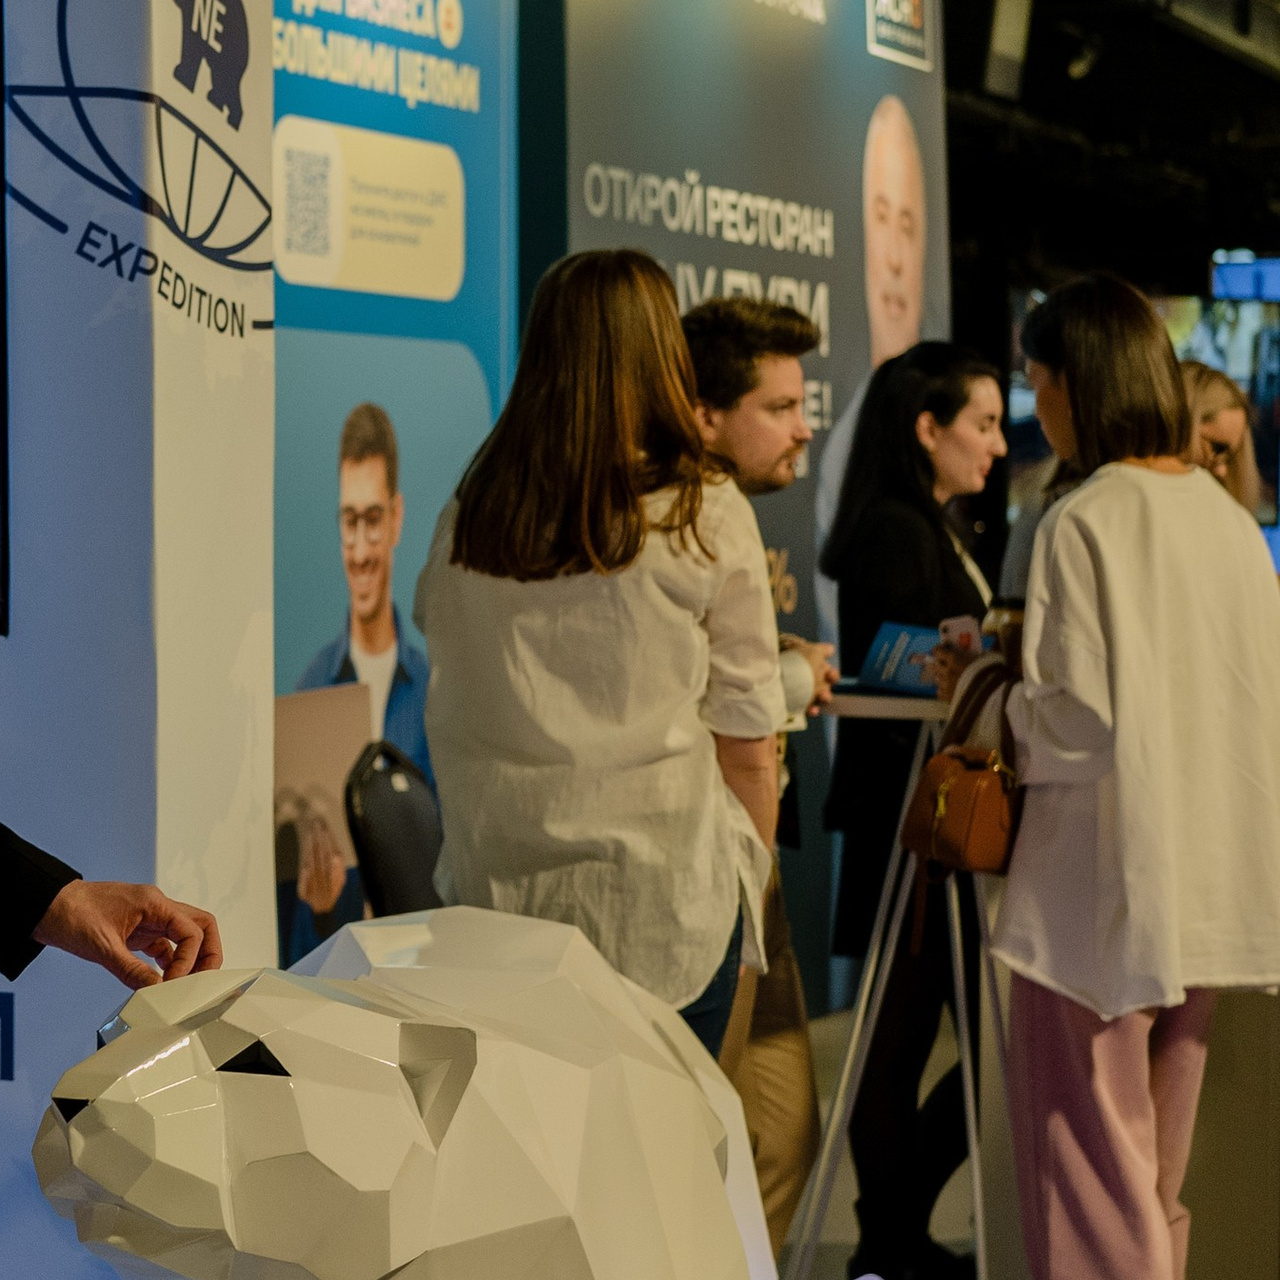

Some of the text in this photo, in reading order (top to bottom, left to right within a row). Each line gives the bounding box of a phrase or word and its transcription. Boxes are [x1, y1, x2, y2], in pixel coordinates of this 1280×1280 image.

[272, 16, 397, 95] БОЛЬШИМИ
[398, 47, 481, 114] ЦЕЛЯМИ
[583, 164, 835, 258] ОТКРОЙ РЕСТОРАН
[75, 221, 246, 339] EXPEDITION
